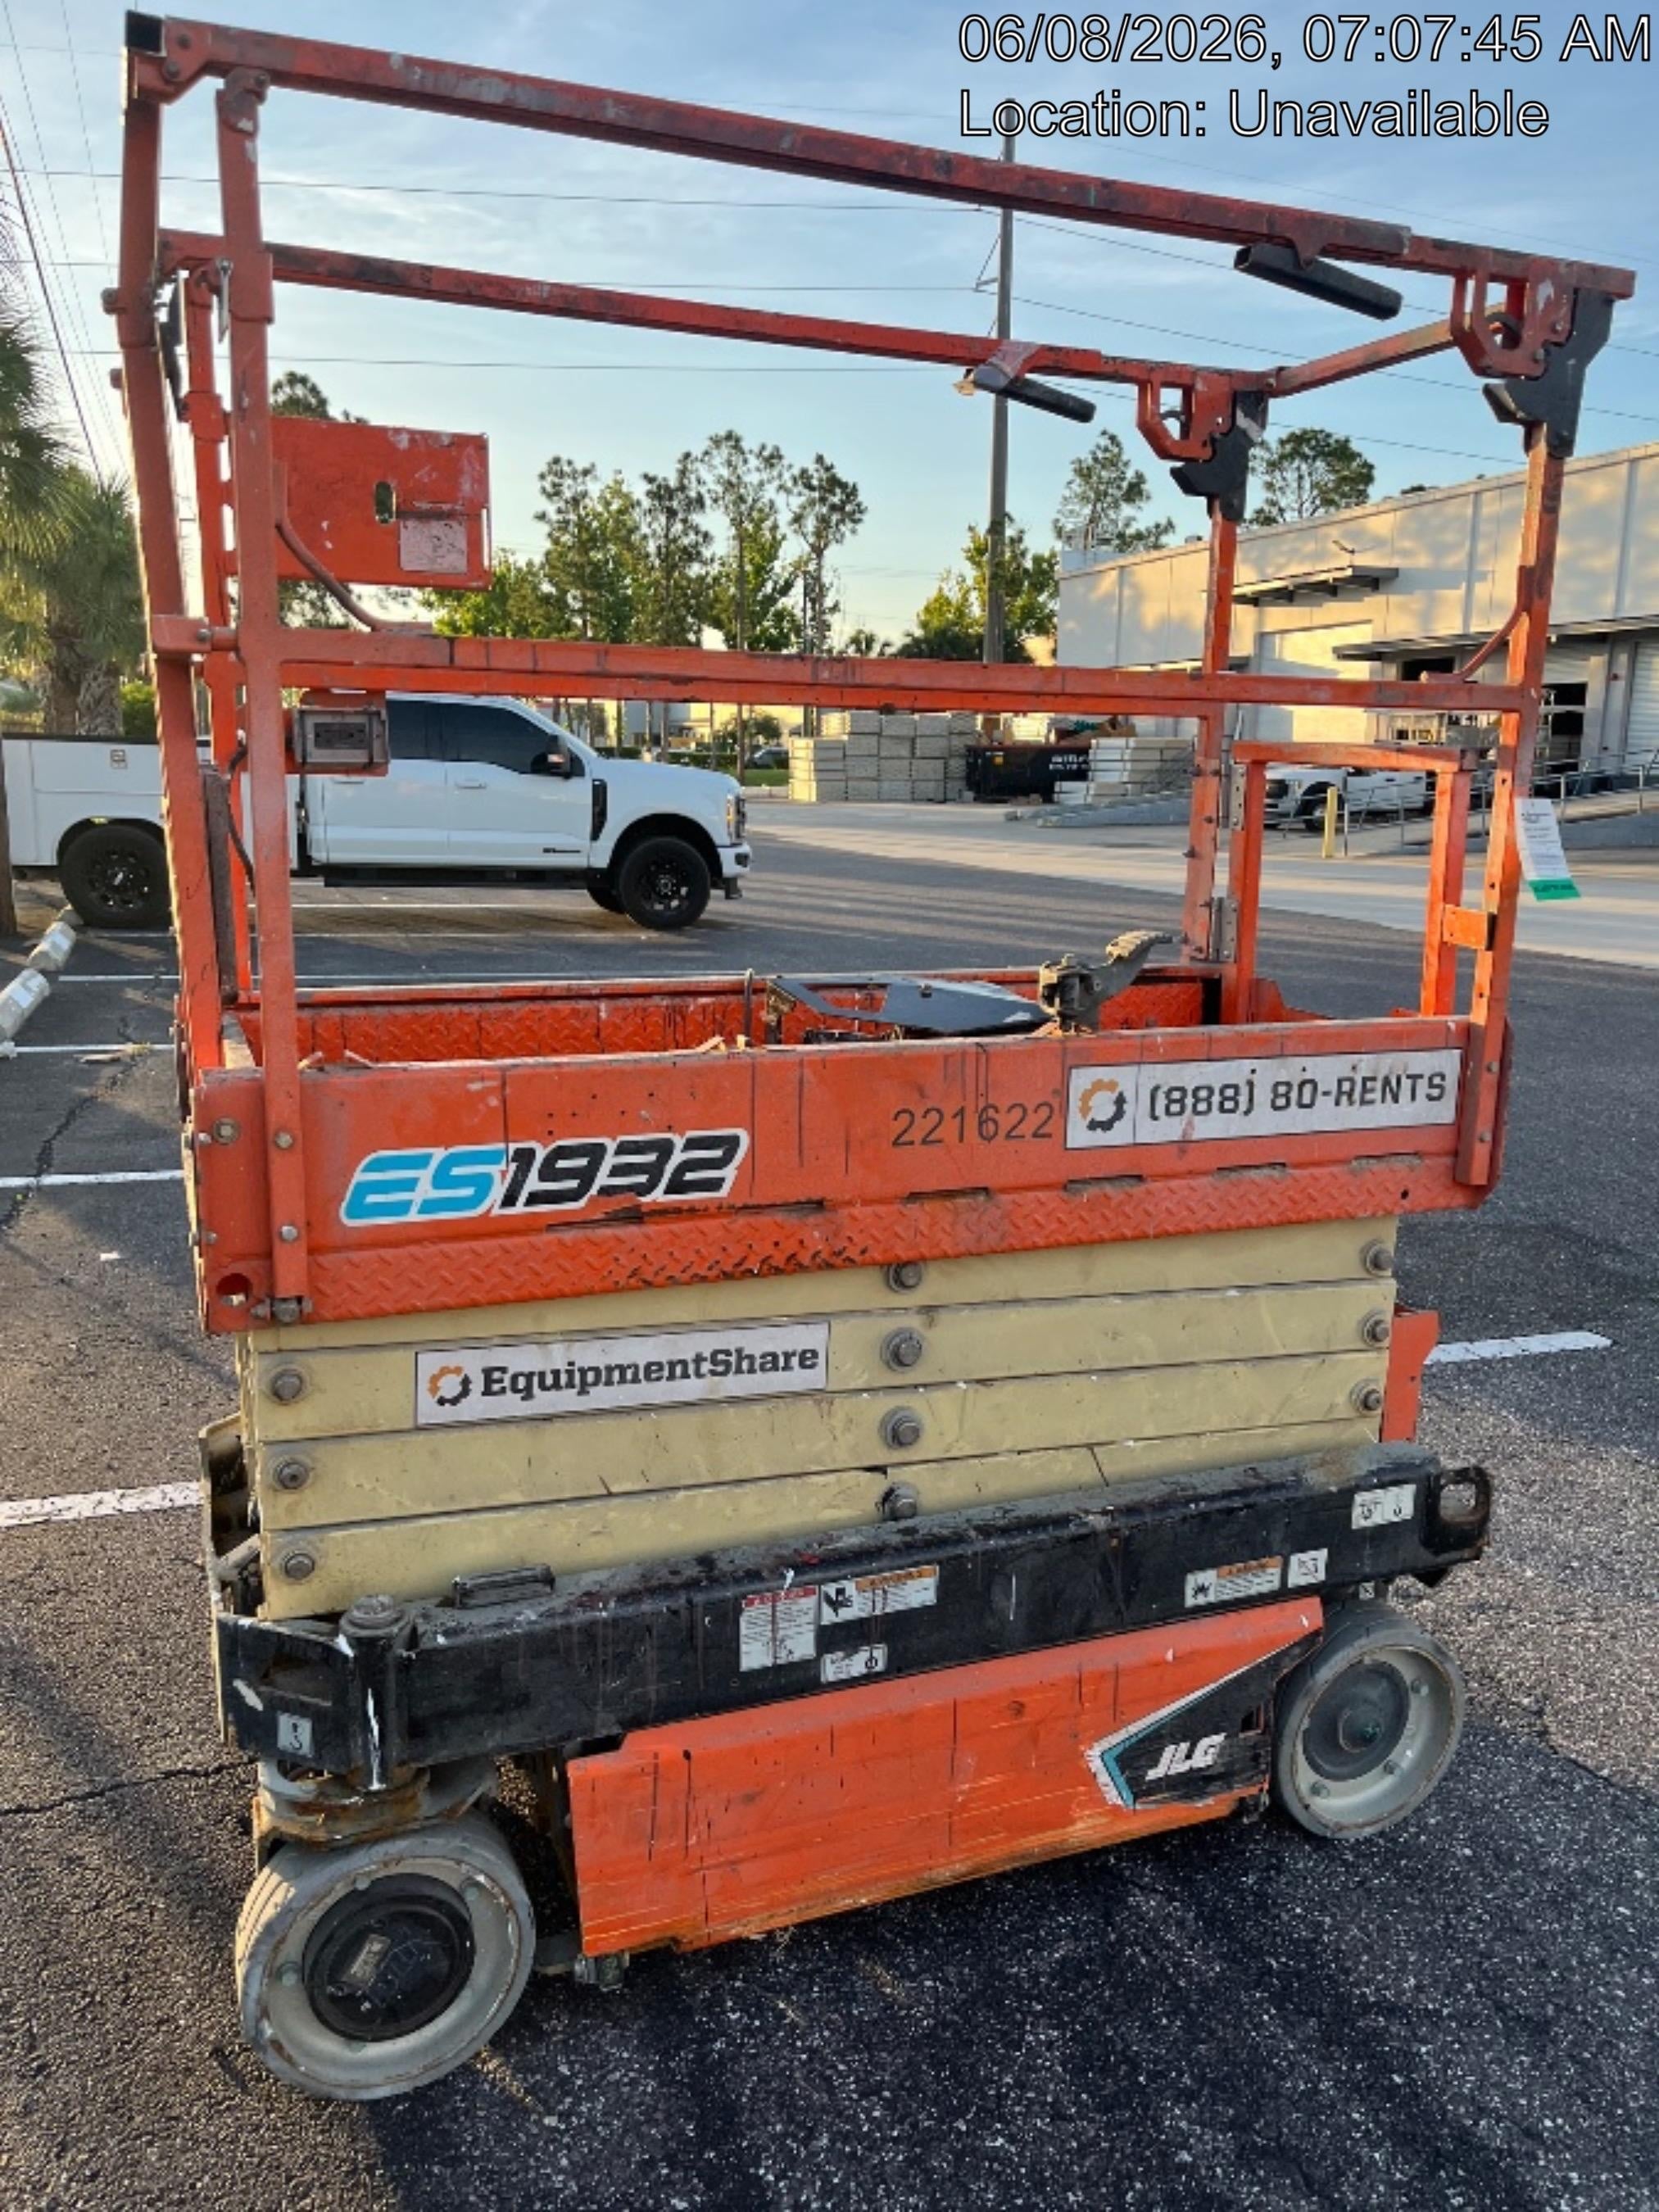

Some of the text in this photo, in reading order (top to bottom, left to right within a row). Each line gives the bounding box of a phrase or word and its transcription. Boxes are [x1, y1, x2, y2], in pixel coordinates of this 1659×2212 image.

[1149, 1072, 1448, 1120] (888) 80-RENTS
[891, 1102, 1054, 1147] 221622
[341, 1130, 746, 1226] ES1932
[480, 1346, 819, 1401] EquipmentShare
[1145, 1732, 1227, 1780] JLG
